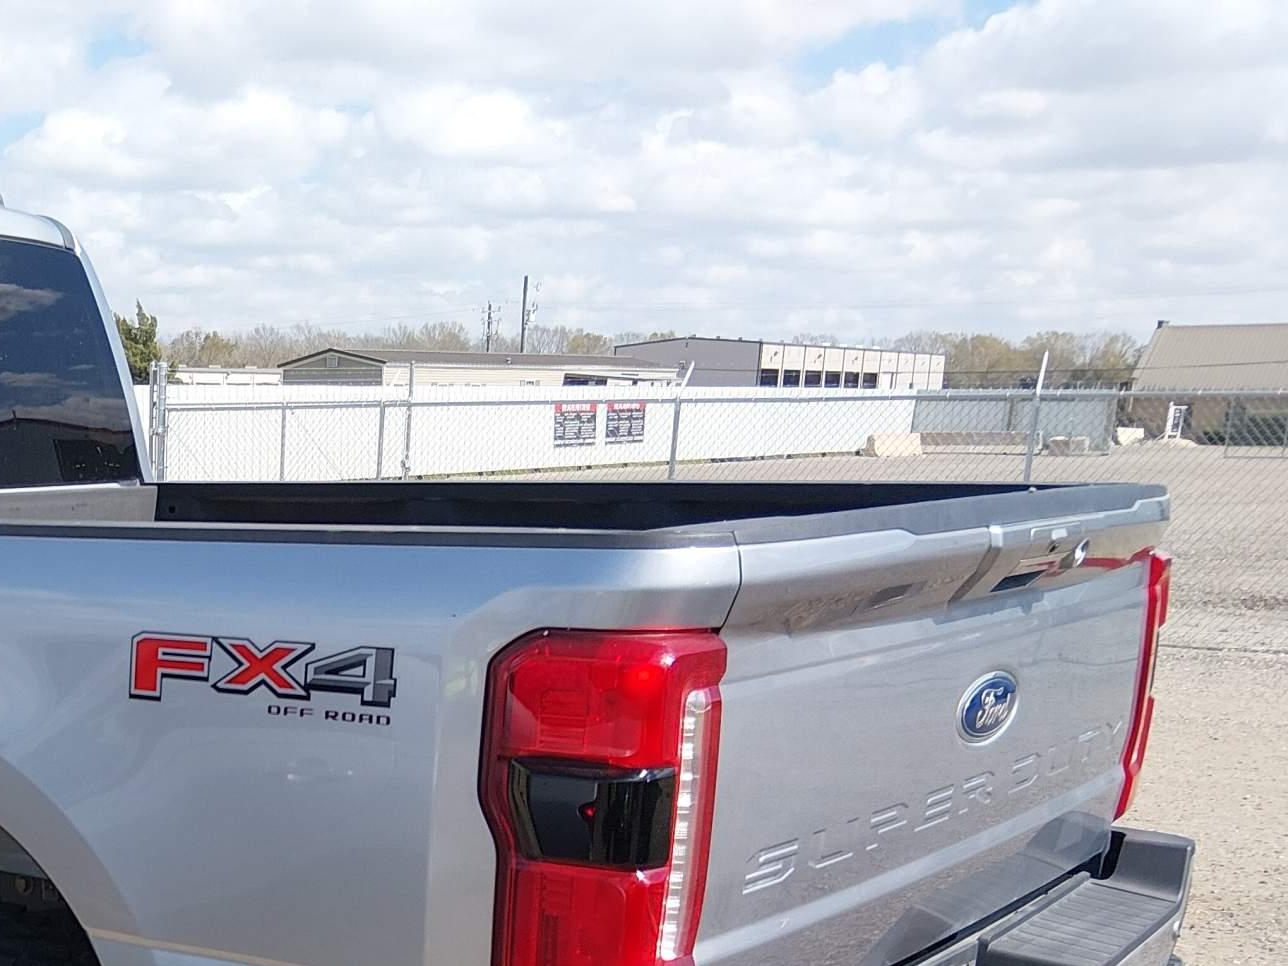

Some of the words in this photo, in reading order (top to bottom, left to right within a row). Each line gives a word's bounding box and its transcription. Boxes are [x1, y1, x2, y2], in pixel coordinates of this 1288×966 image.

[129, 630, 397, 708] FX4
[267, 704, 314, 718] OFF
[324, 709, 392, 726] ROAD
[741, 770, 996, 896] SUPER
